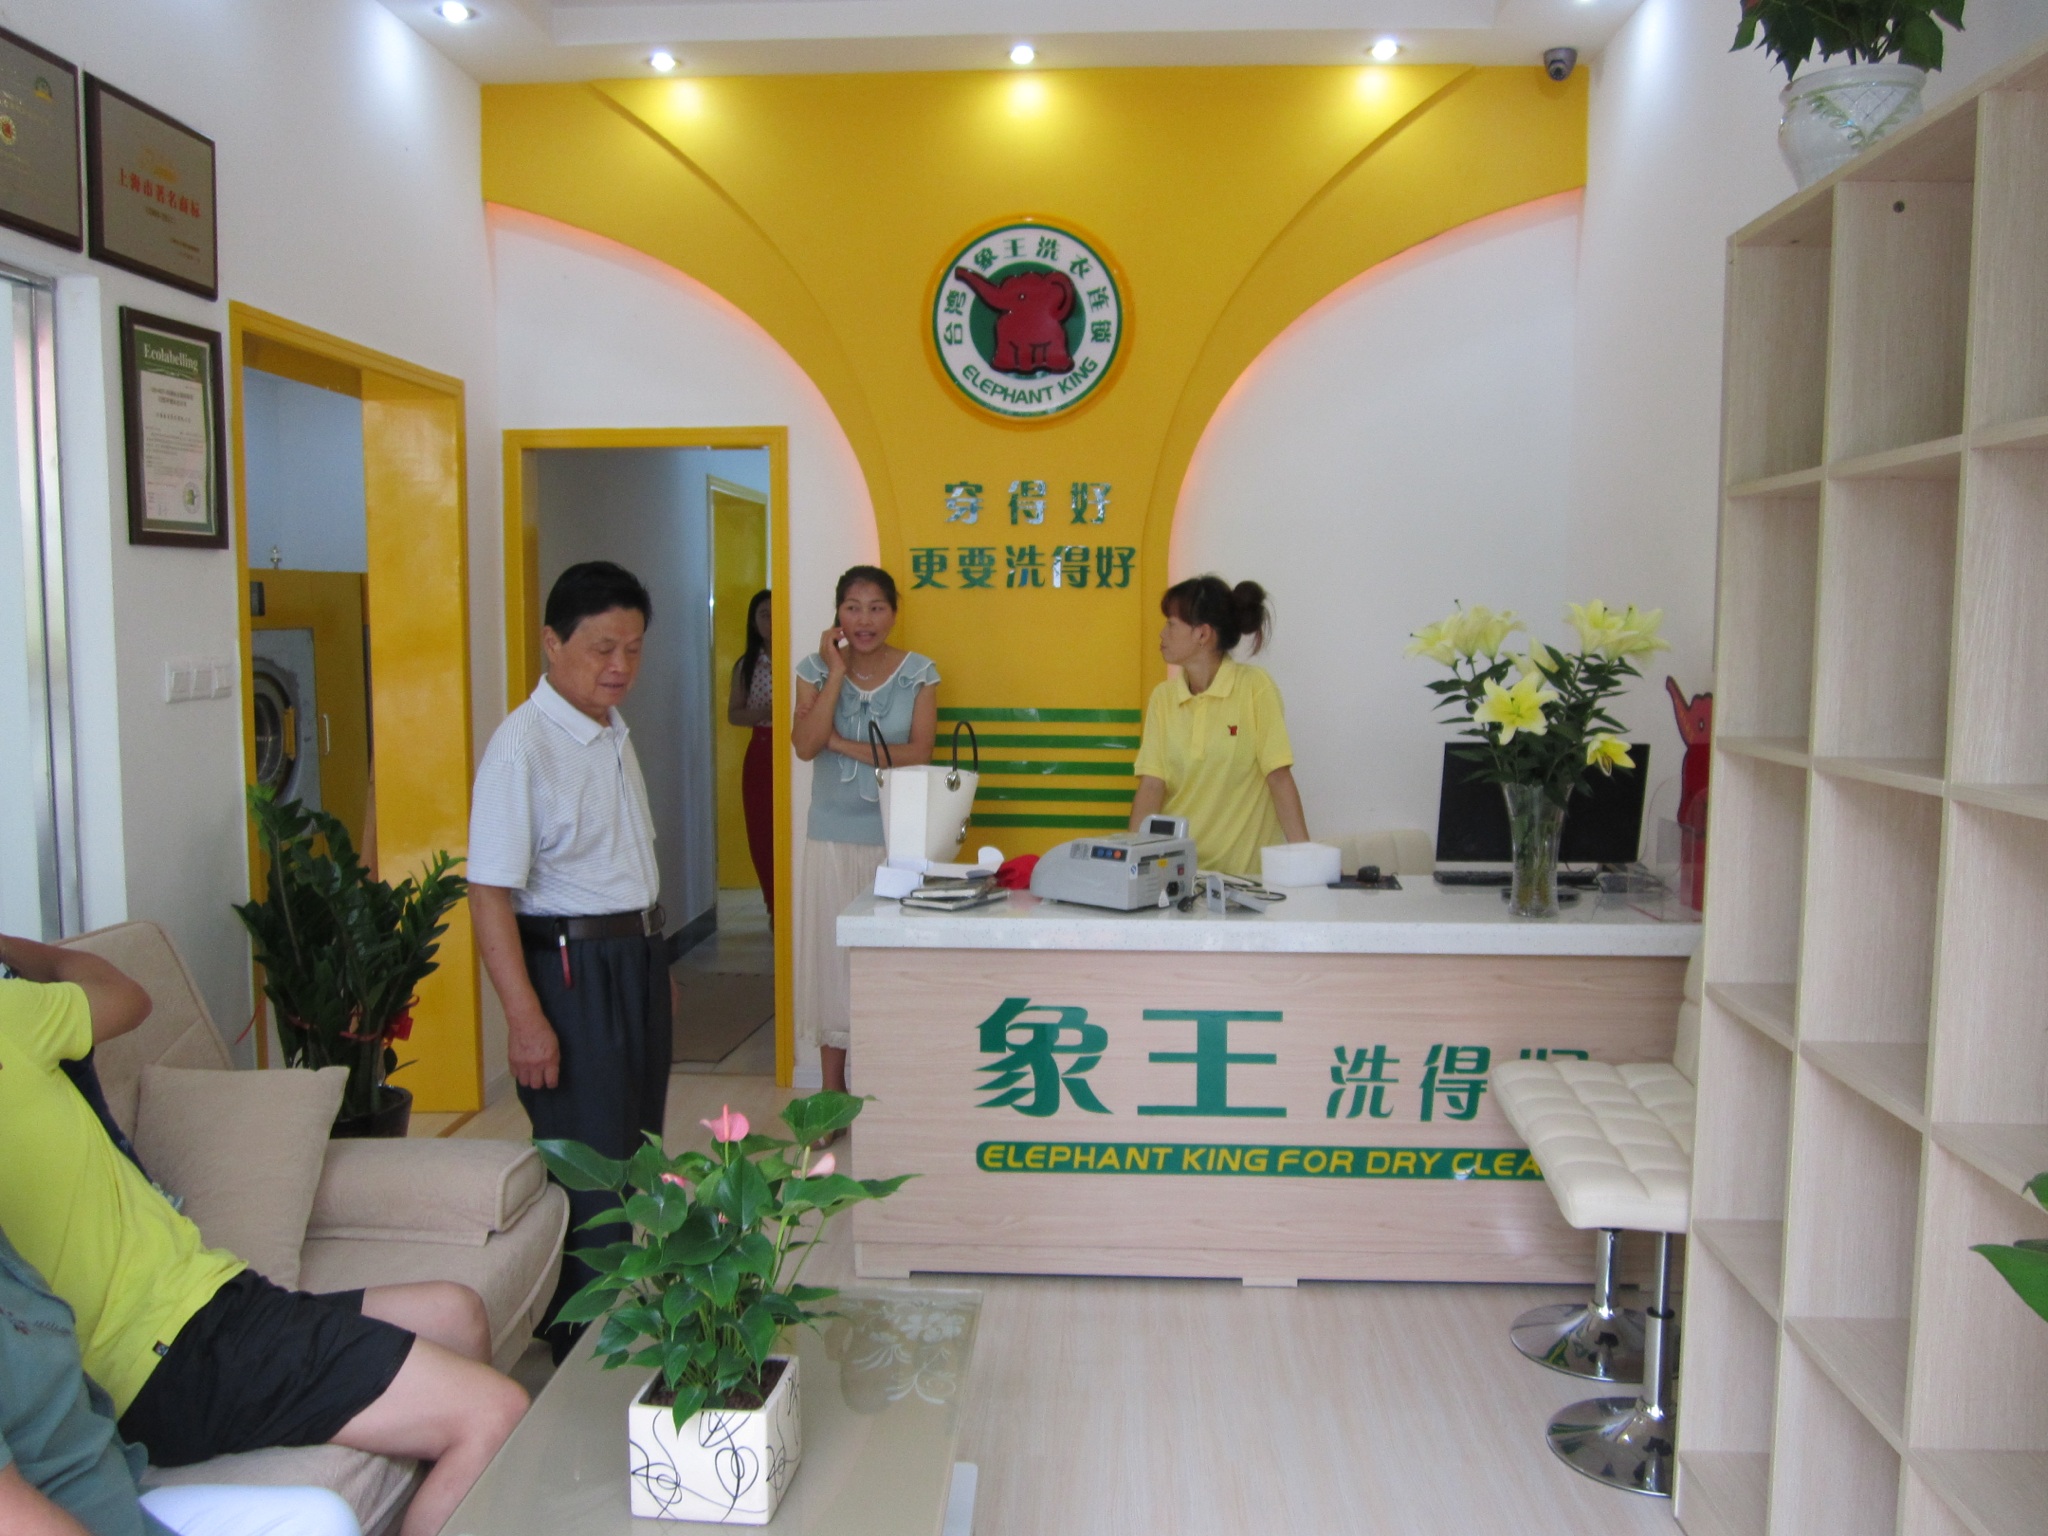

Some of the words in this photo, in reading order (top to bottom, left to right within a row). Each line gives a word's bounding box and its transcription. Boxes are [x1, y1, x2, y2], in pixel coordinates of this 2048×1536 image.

[143, 343, 198, 371] Ecolabelling
[962, 364, 1054, 405] ELEPHANT
[1057, 356, 1099, 395] KING
[944, 480, 1112, 525] 穿得好
[909, 544, 1137, 589] 更要洗得好
[973, 997, 1288, 1119] 象王
[1326, 1042, 1590, 1123] 洗得
[983, 1144, 1174, 1171] ELEPHANT
[1181, 1146, 1269, 1172] KING
[1277, 1149, 1354, 1174] FOR
[1365, 1151, 1443, 1175] DRY
